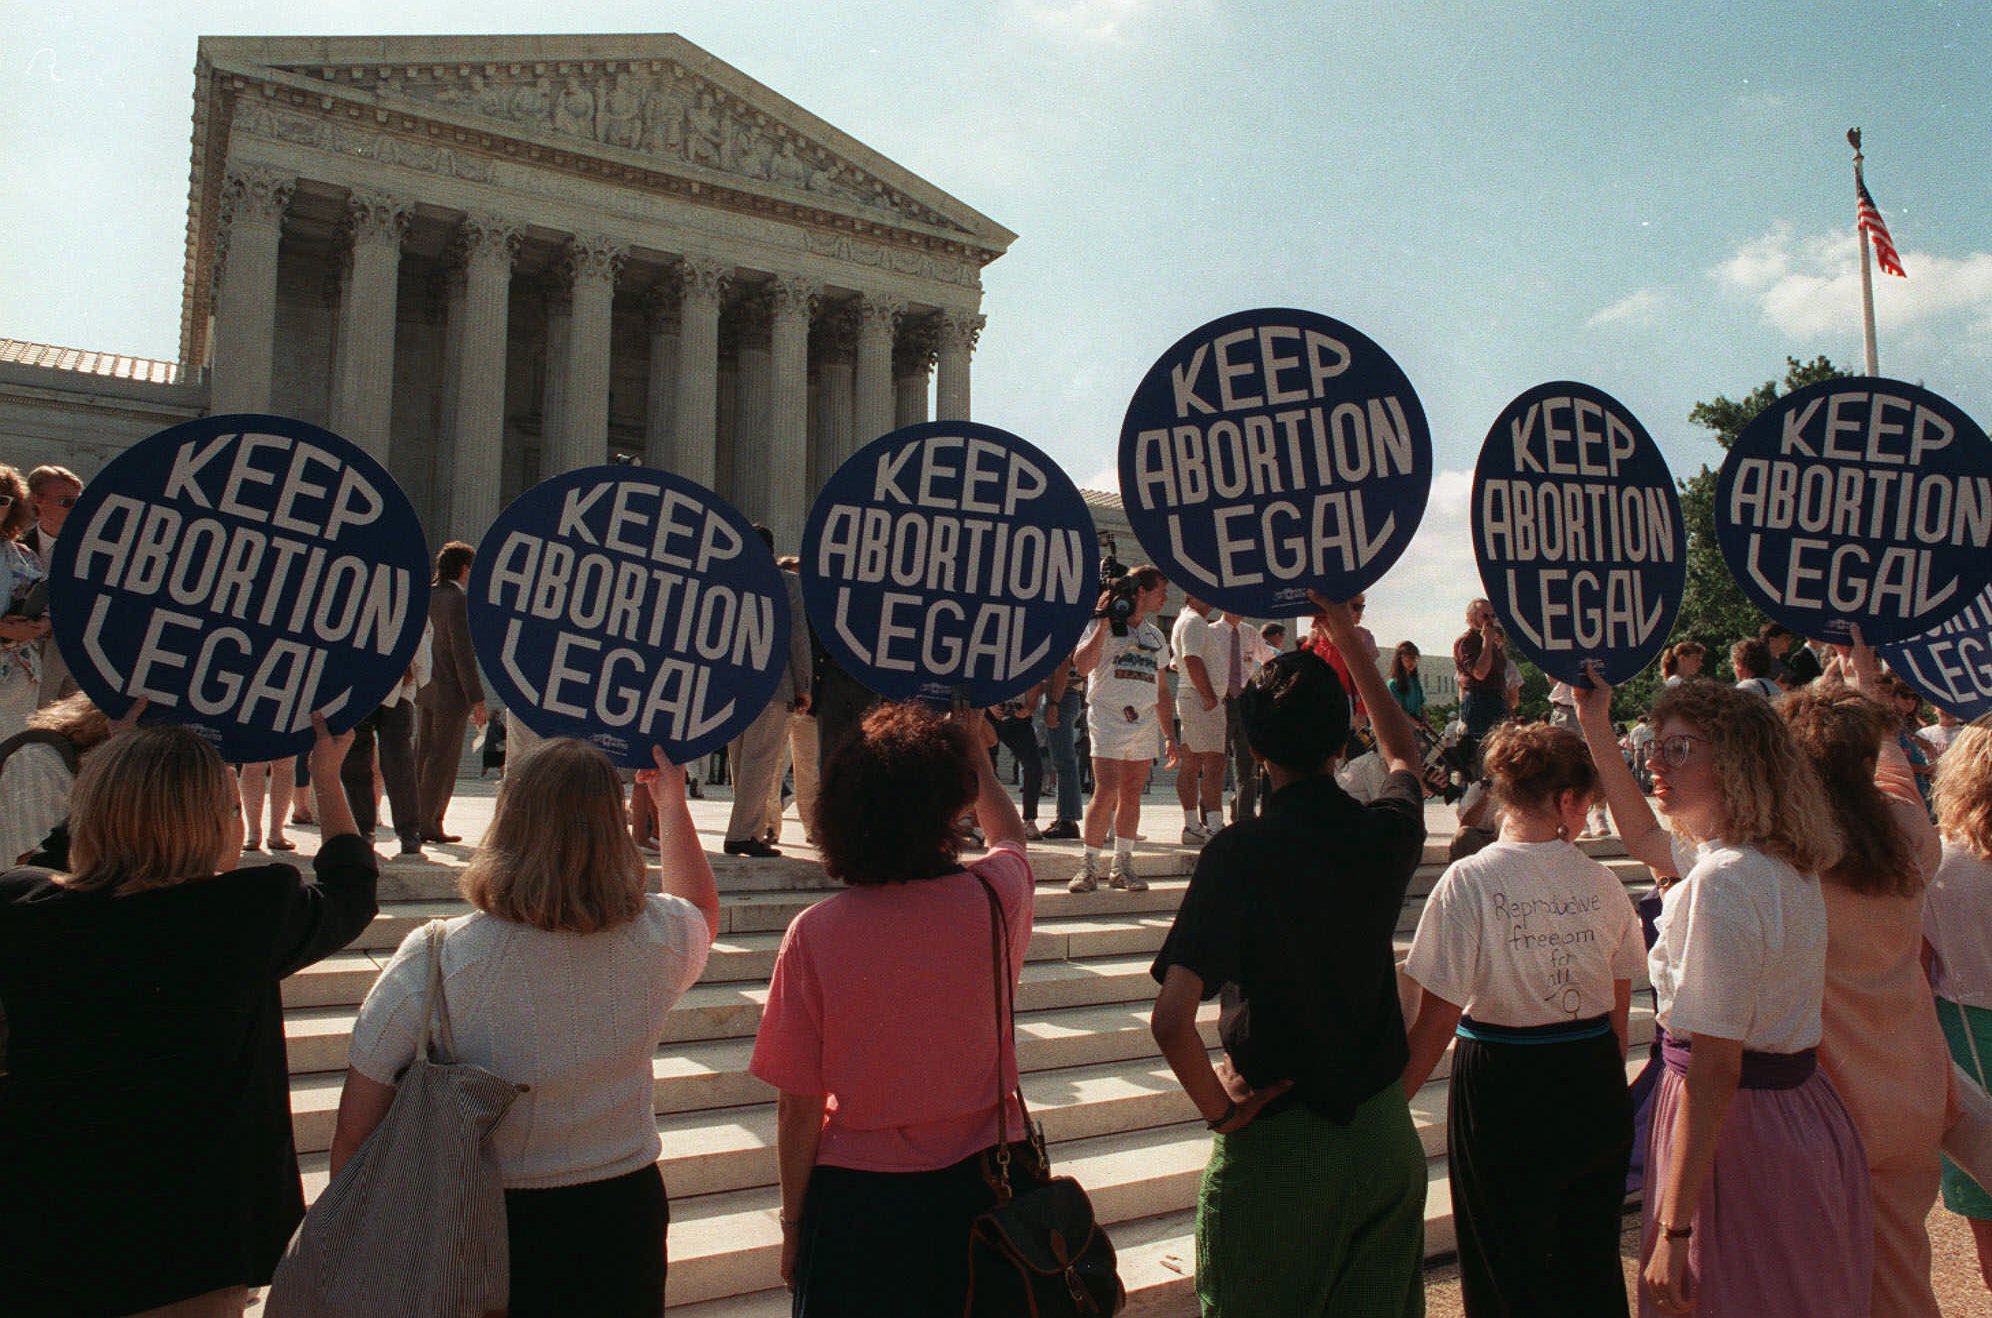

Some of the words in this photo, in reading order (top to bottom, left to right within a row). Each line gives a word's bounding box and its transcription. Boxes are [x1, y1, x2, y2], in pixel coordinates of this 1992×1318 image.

[1172, 326, 1350, 418] KEEP
[1136, 396, 1413, 510] ABORTION
[1511, 397, 1635, 477] KEEP
[1781, 392, 1955, 466] KEEP
[164, 433, 383, 541] KEEP
[873, 437, 1047, 516] KEEP
[1483, 479, 1673, 563] ABORTION
[1730, 458, 1992, 547] ABORTION
[558, 481, 743, 573] KEEP
[818, 504, 1083, 604] ABORTION
[1168, 489, 1395, 588] LEGAL
[74, 493, 411, 657] ABORTION
[488, 531, 774, 671] ABORTION
[1506, 569, 1662, 650] LEGAL
[1747, 534, 1958, 618] LEGAL
[82, 594, 352, 734] LEGAL
[501, 619, 736, 741] LEGAL
[834, 587, 1051, 681] LEGAL
[1902, 632, 1992, 703] LEG
